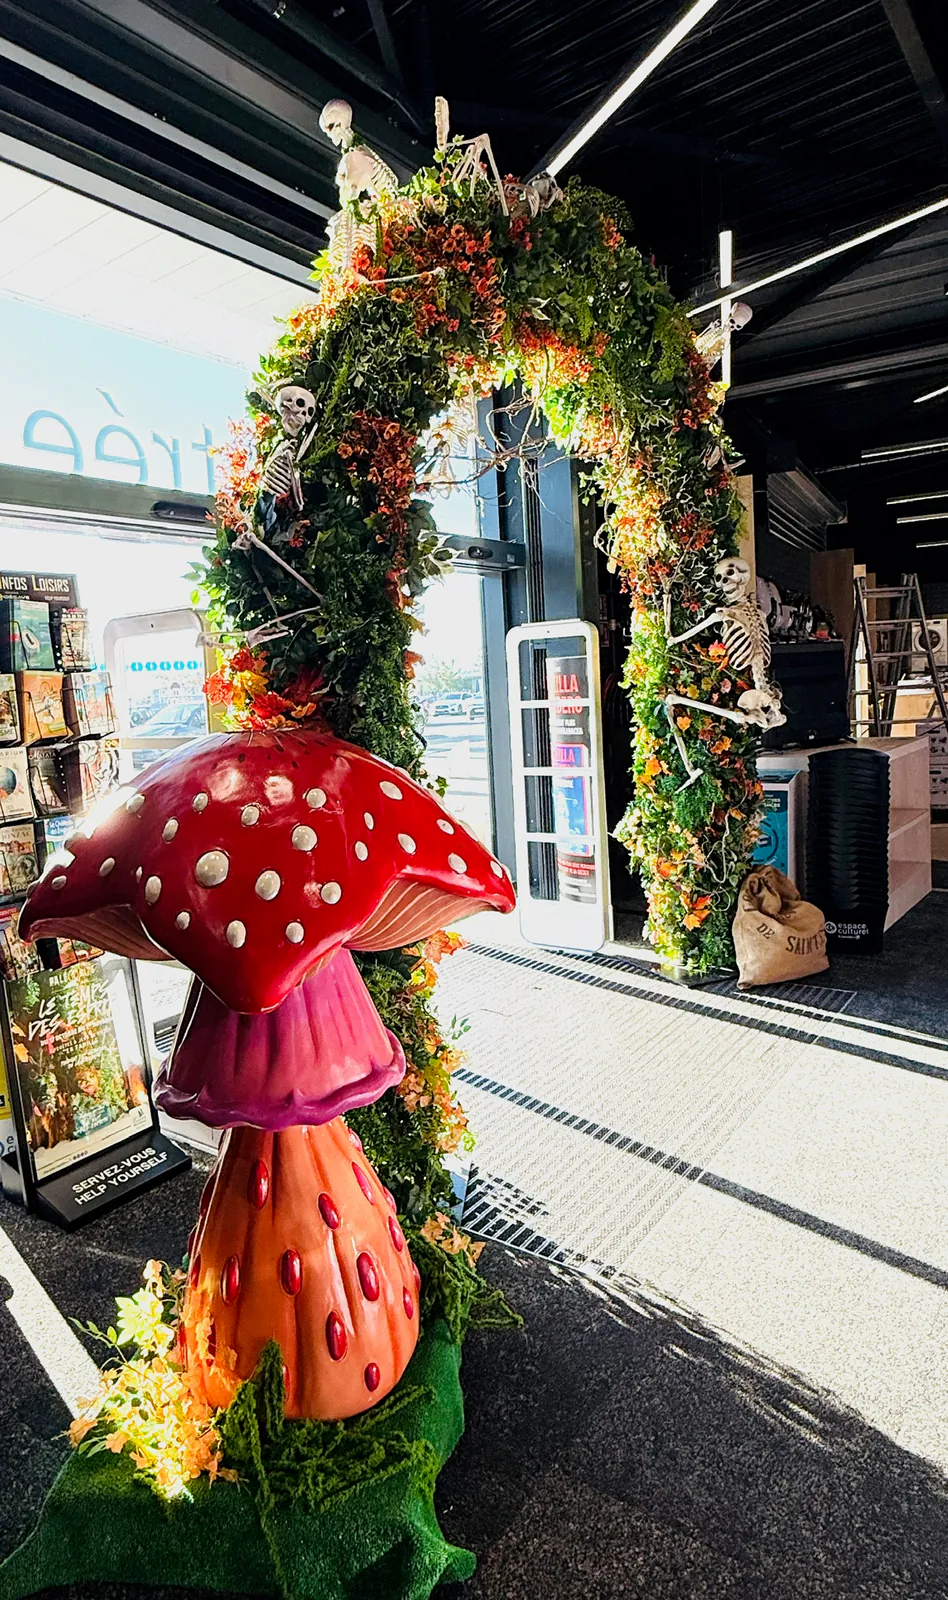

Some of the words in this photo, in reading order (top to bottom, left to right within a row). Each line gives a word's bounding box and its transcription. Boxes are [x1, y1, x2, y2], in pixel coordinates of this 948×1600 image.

[32, 575, 70, 592] LOISIRS
[756, 922, 776, 939] DE
[837, 922, 867, 931] espace
[837, 928, 870, 936] culturel
[786, 929, 827, 955] SAINTE
[38, 996, 56, 1019] LE
[59, 979, 109, 1009] TEMPS
[28, 1013, 61, 1041] DES
[68, 998, 113, 1026] ESPRI
[72, 1147, 156, 1194] SERVEZ-VOUS
[75, 1183, 109, 1206] HELP
[110, 1152, 169, 1187] YOURSELF
